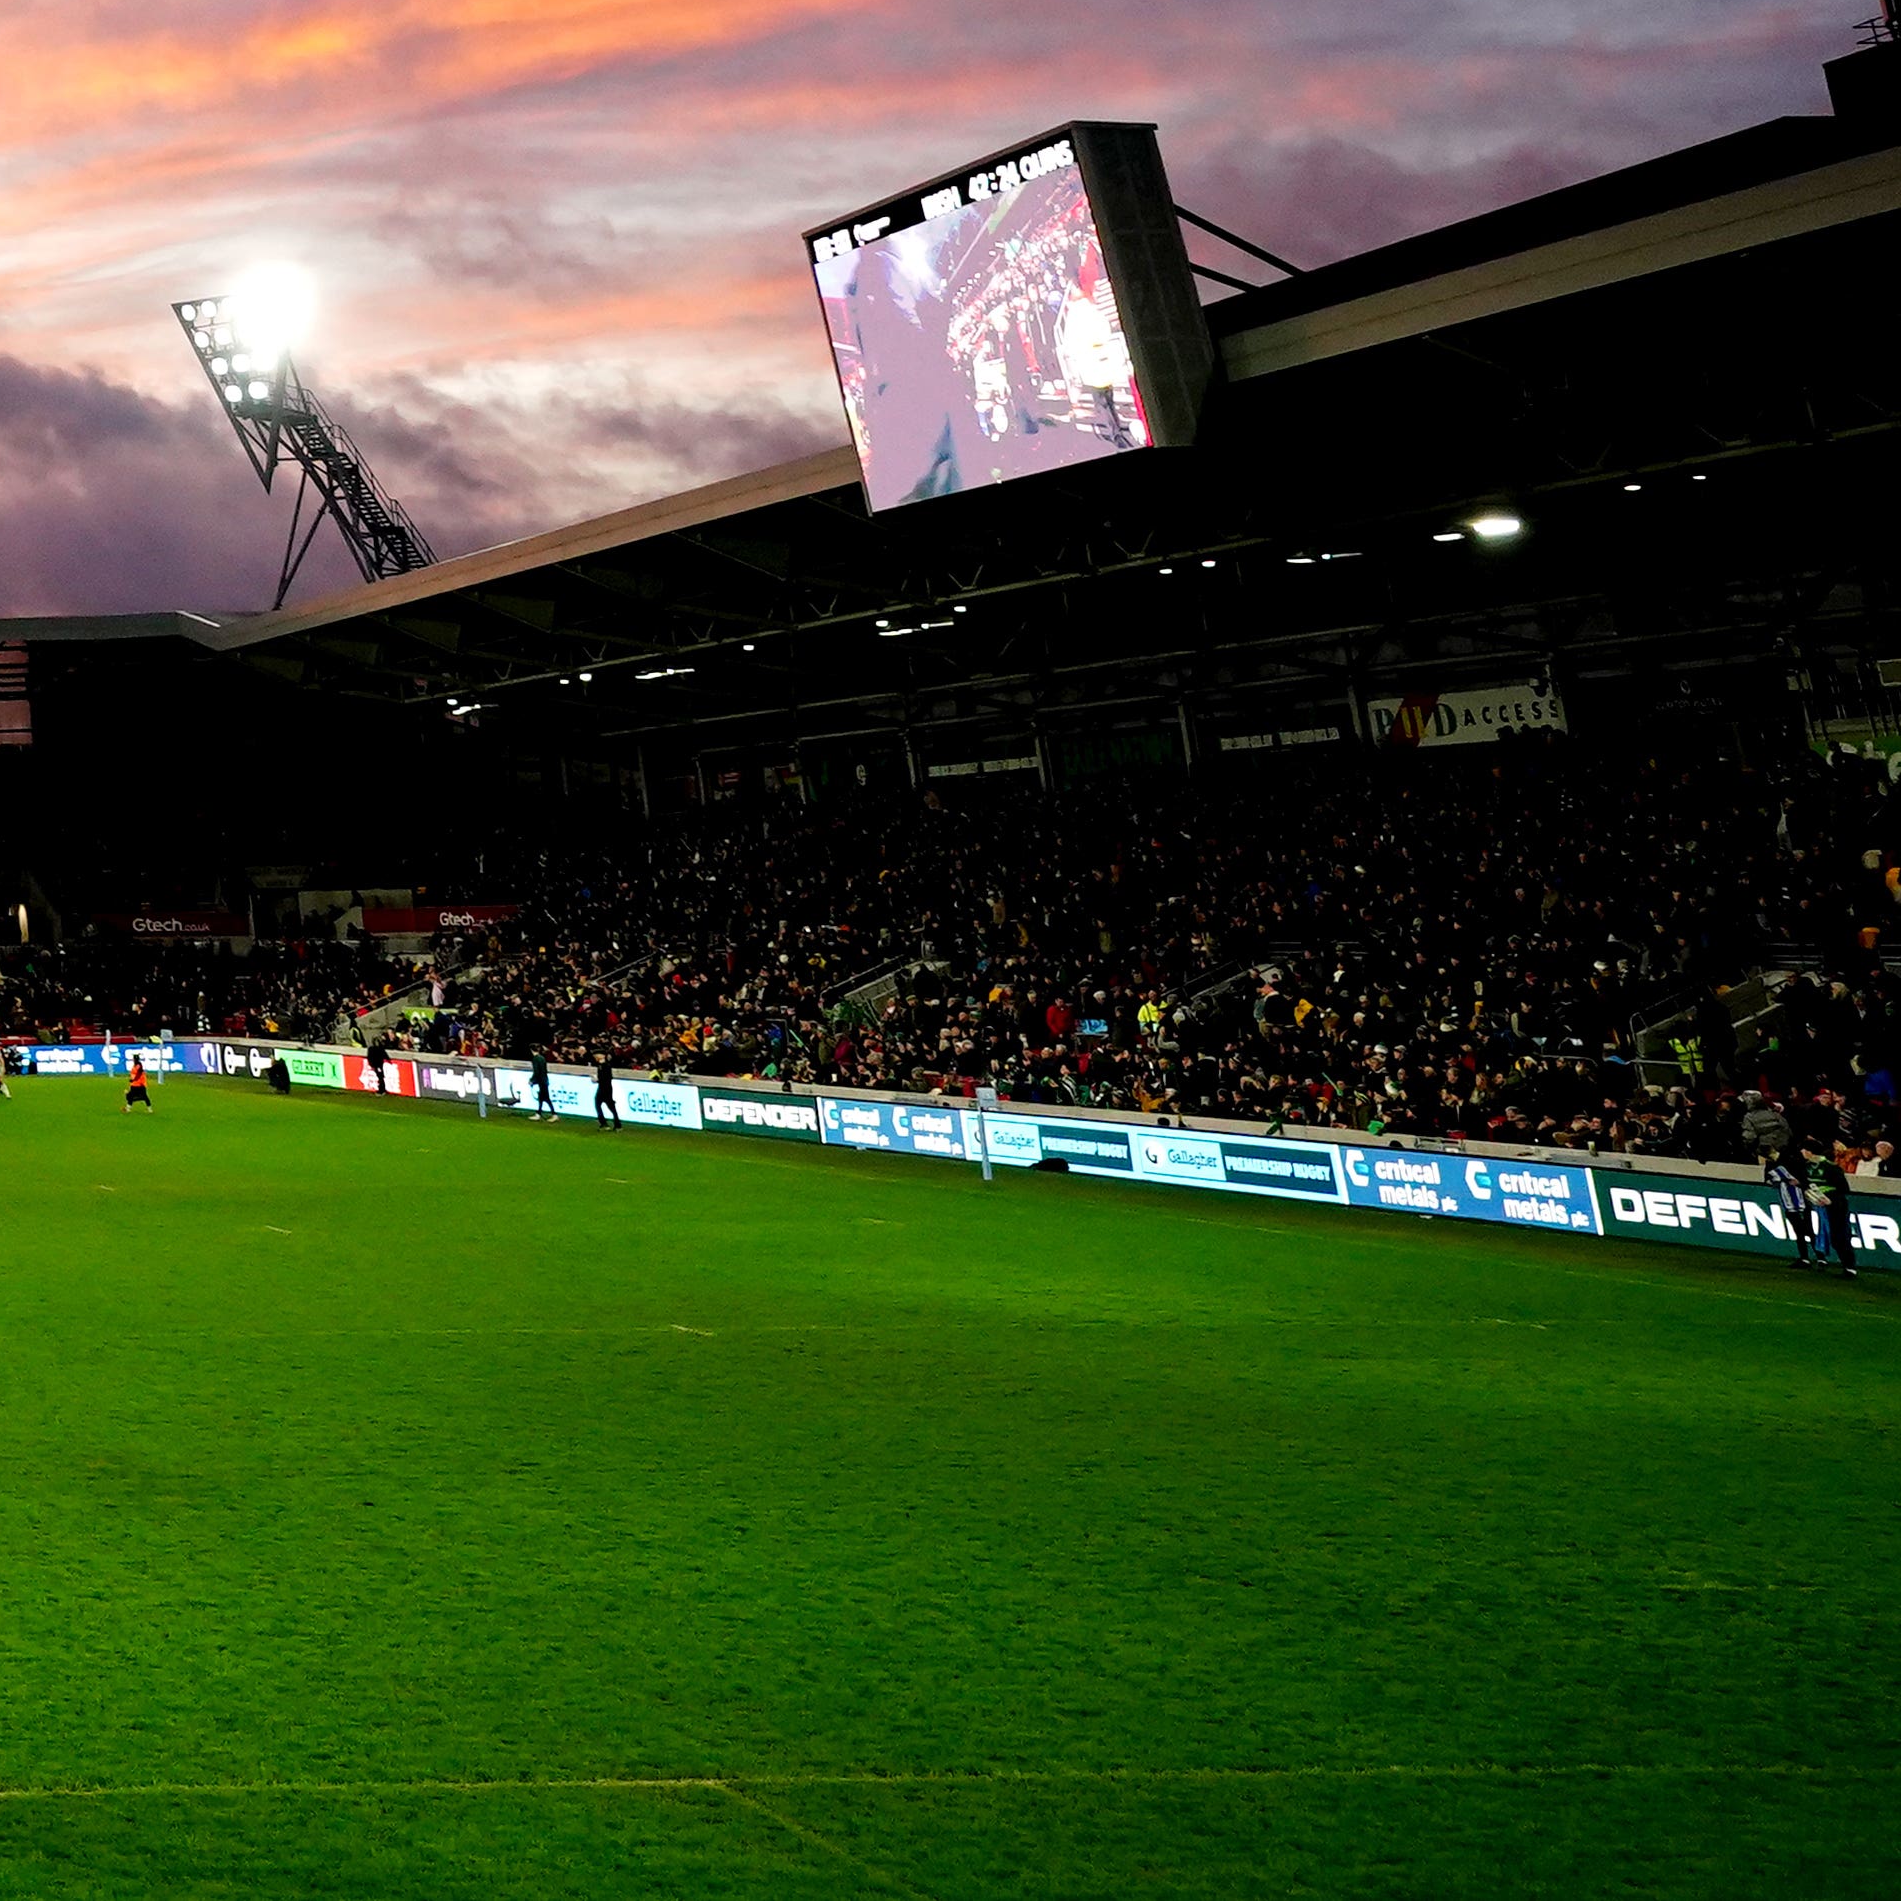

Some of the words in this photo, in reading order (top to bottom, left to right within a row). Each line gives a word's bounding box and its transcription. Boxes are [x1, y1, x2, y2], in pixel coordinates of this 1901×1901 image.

[1463, 700, 1559, 726] ACCESS
[132, 917, 211, 933] Gtech.co.uk
[627, 1090, 683, 1120] Gallagher
[702, 1098, 818, 1131] DEFENDER
[1167, 1147, 1218, 1169] Gallagher
[1374, 1158, 1441, 1185] critical
[1378, 1184, 1439, 1210] metals
[1498, 1171, 1571, 1199] critical
[1503, 1198, 1569, 1225] metals
